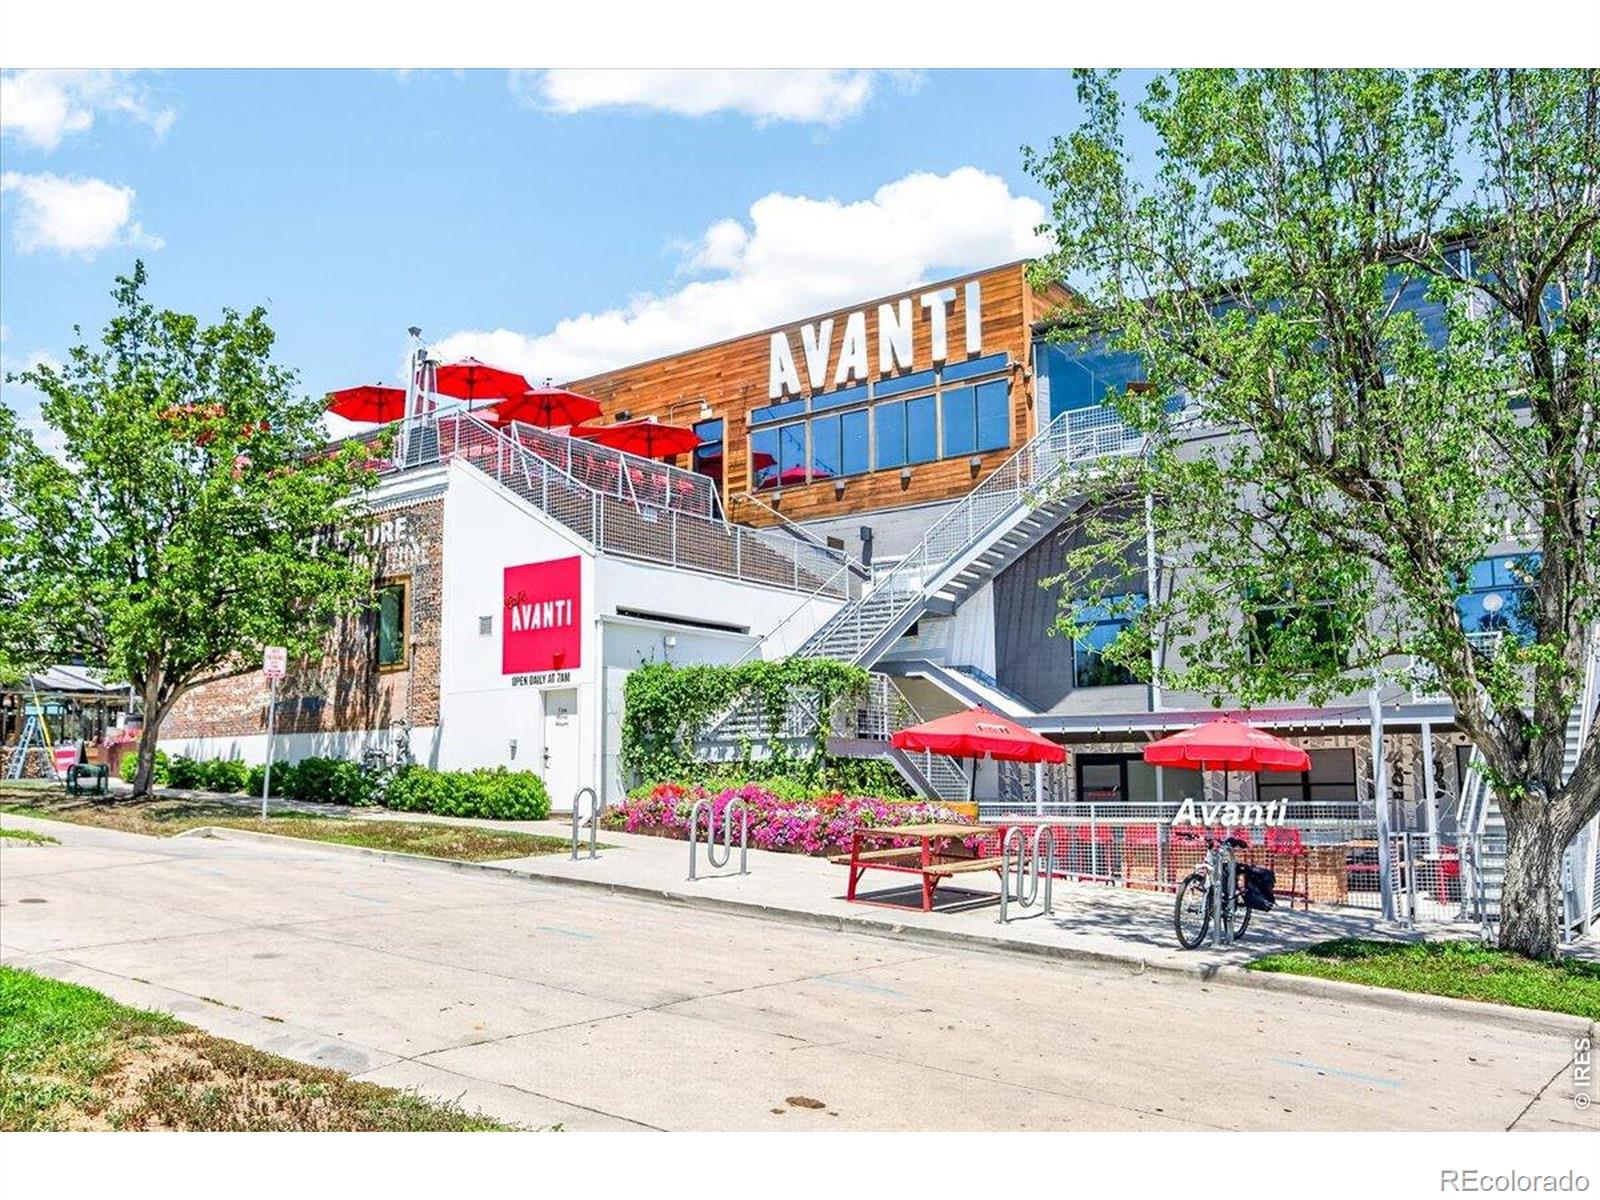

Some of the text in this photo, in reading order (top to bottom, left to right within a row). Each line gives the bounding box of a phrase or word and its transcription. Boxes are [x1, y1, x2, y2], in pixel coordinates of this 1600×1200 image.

[768, 280, 982, 399] AVANTI
[511, 599, 572, 632] AVANTI
[511, 671, 570, 687] OPEN DAILY AT 7AM
